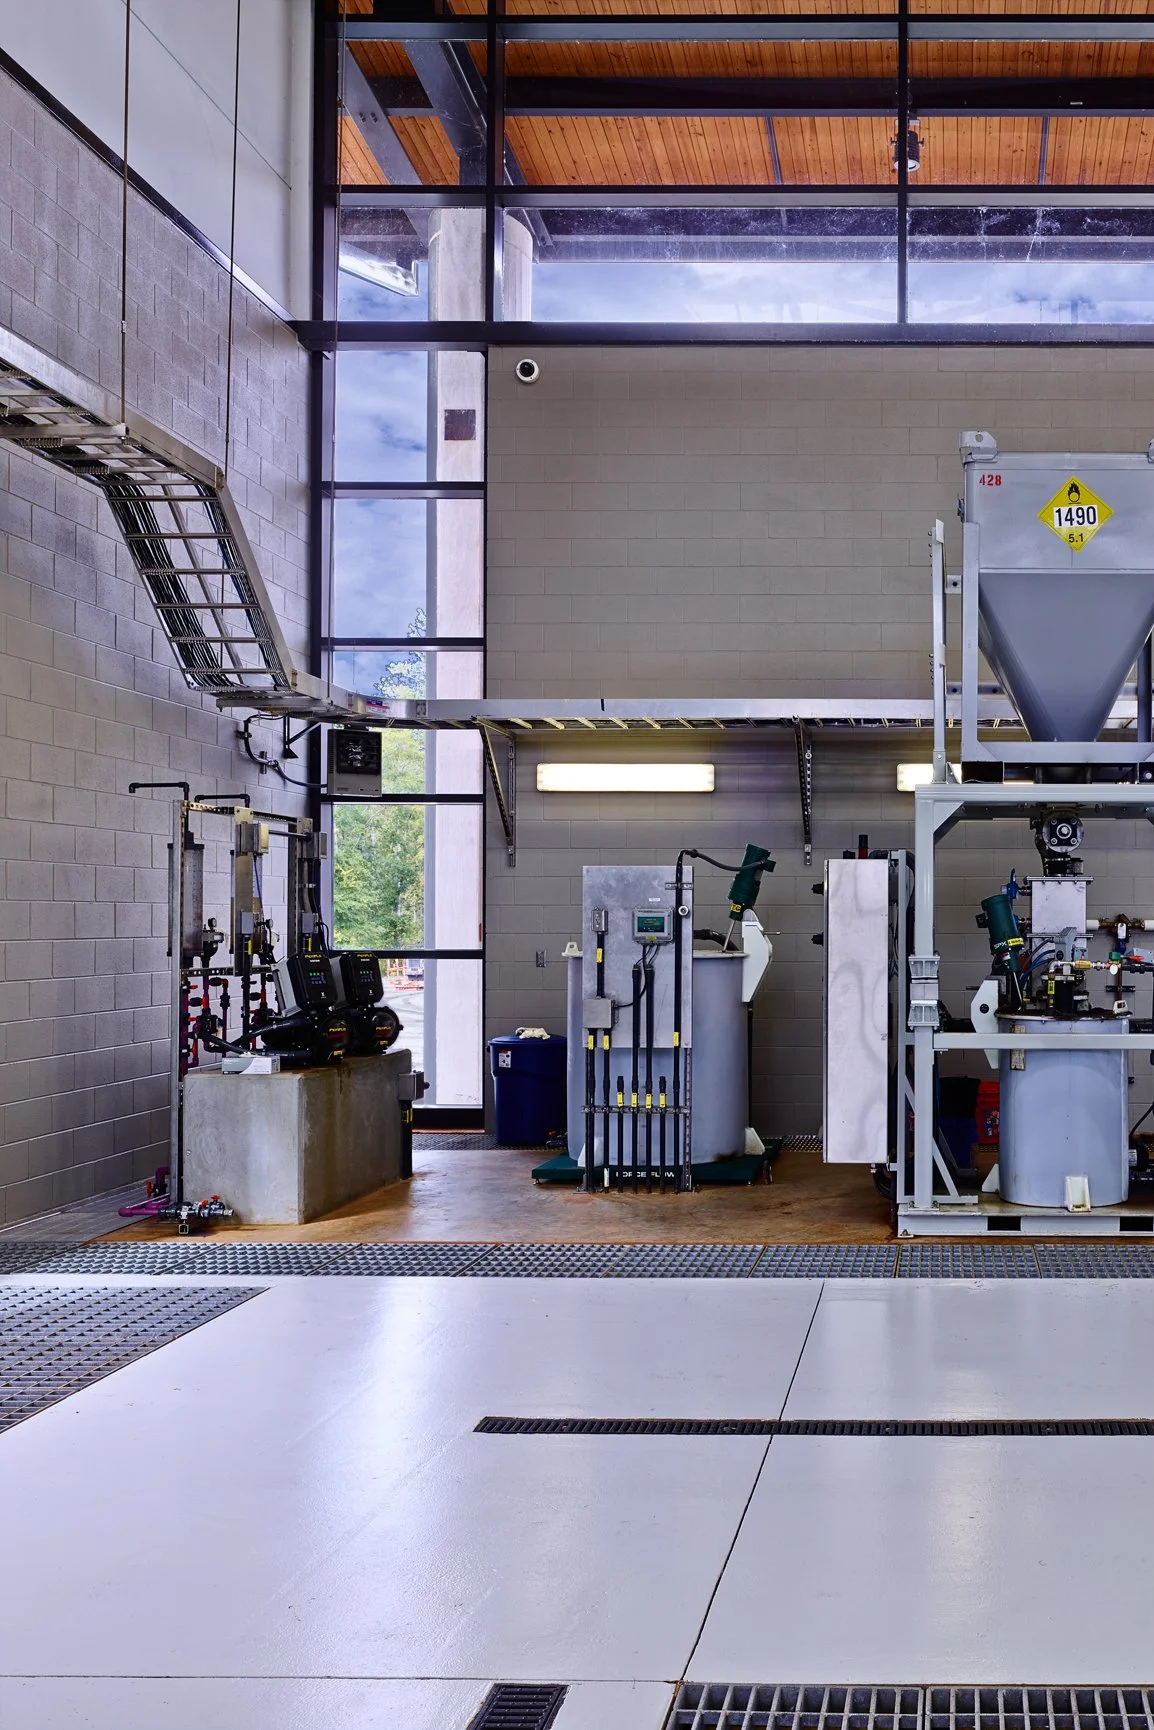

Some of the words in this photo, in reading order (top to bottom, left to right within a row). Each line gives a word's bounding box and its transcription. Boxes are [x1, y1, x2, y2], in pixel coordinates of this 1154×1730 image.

[979, 474, 1002, 487] 428
[1054, 505, 1097, 527] 1490
[1068, 533, 1084, 543] 5.1
[994, 941, 1007, 950] SPX
